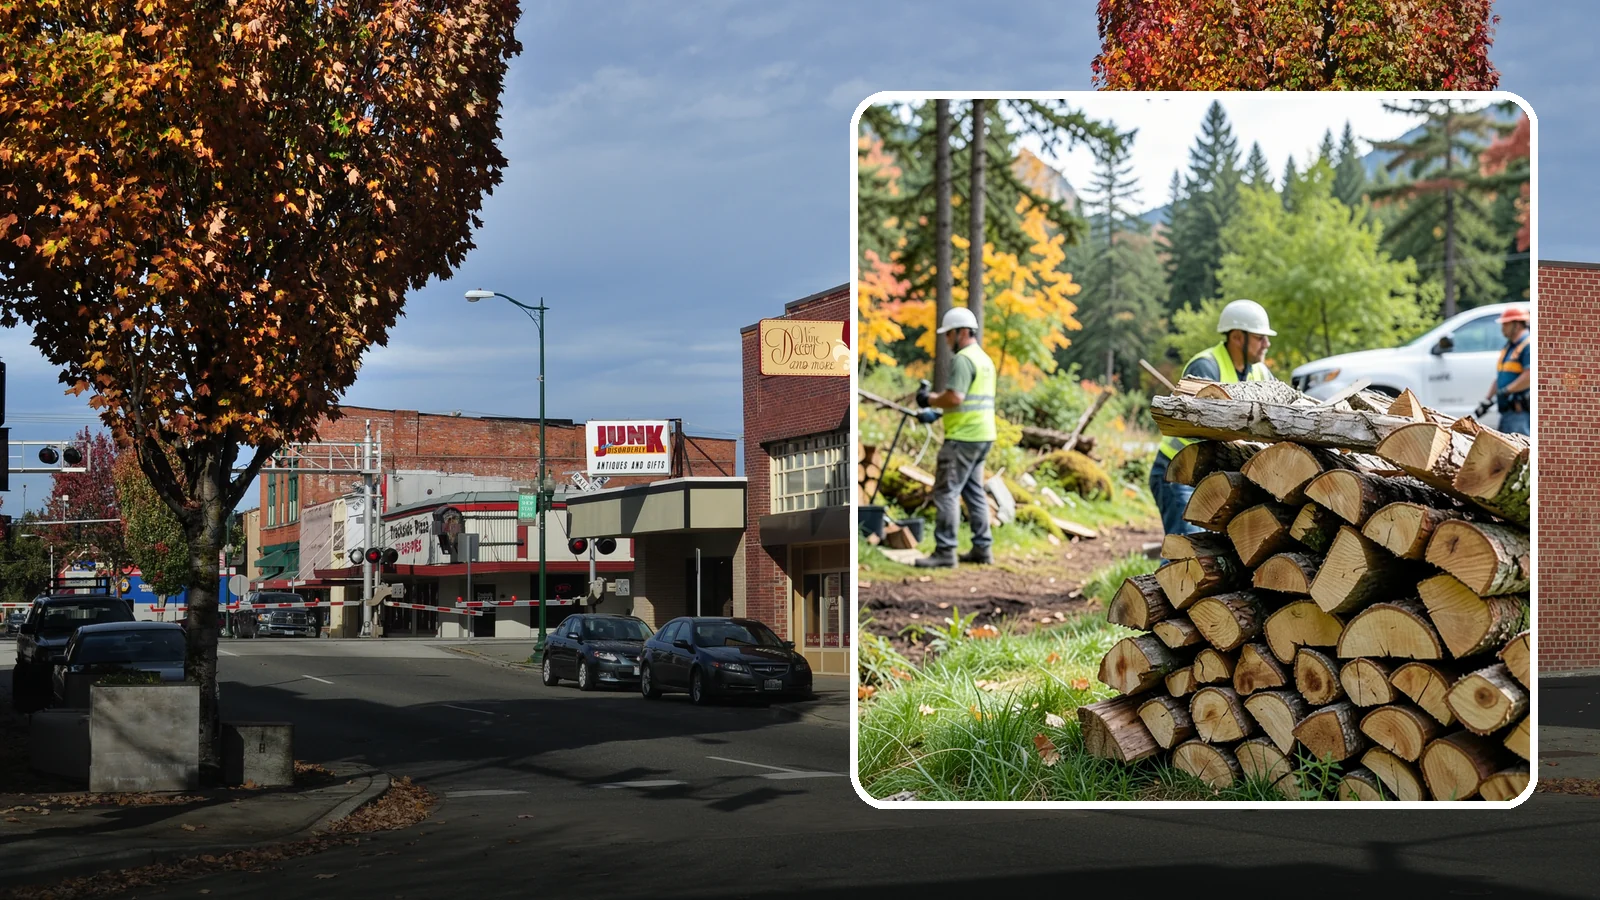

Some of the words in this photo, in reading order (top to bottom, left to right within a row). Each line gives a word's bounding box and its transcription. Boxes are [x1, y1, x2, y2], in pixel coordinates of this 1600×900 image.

[765, 328, 831, 365] Decor
[595, 425, 665, 457] JUNK
[607, 446, 645, 454] DISORDERLY
[597, 461, 628, 470] ANTIQUES
[631, 461, 643, 470] AND
[647, 460, 665, 469] GIFTS
[414, 519, 429, 534] Pizza
